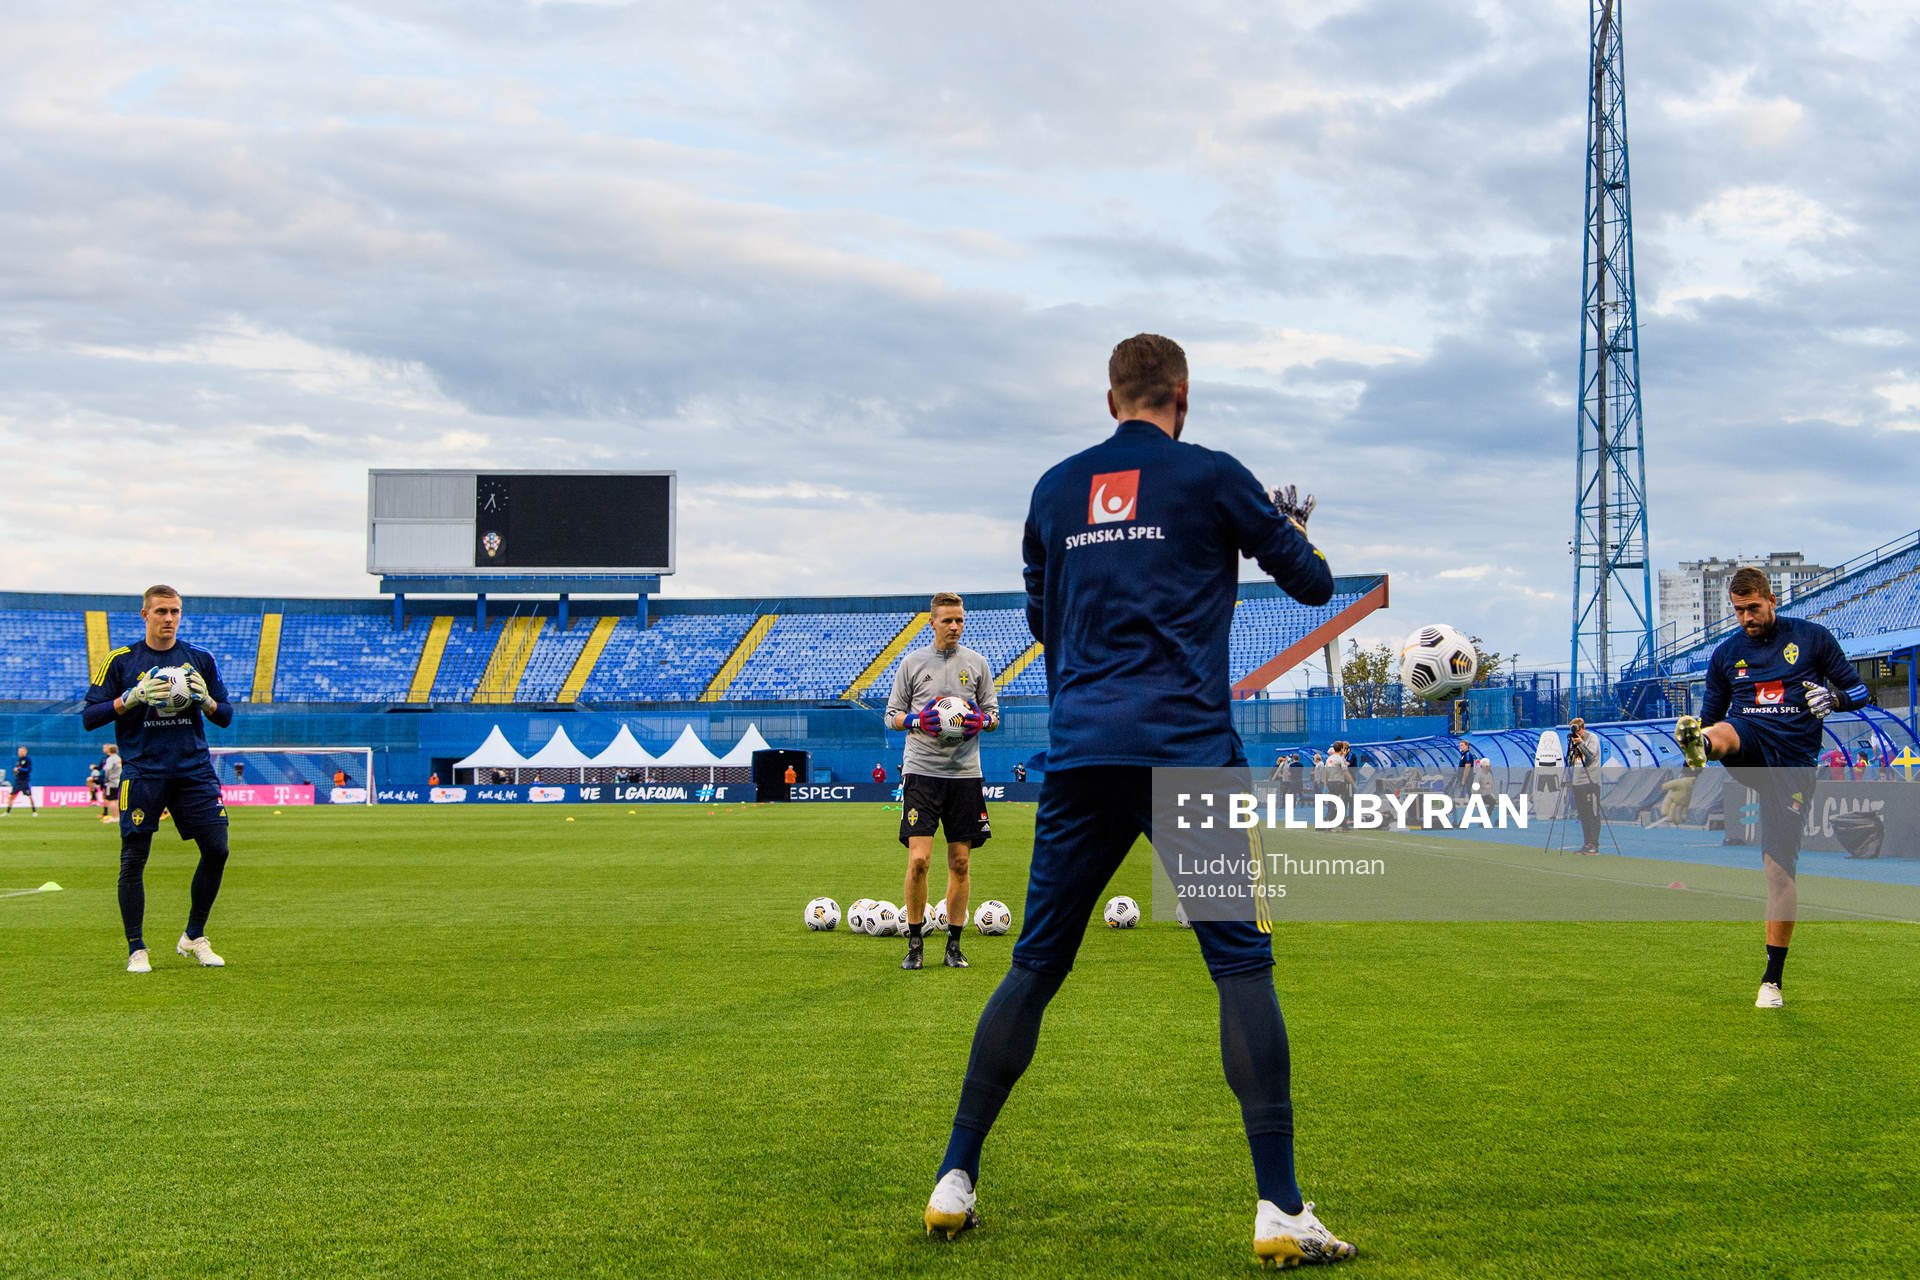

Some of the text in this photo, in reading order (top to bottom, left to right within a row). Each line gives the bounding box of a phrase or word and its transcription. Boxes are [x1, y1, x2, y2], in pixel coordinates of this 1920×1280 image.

[1065, 526, 1165, 550] SVENSKA SPEL
[143, 720, 176, 728] SVENSKA
[790, 786, 855, 800] ESPECT
